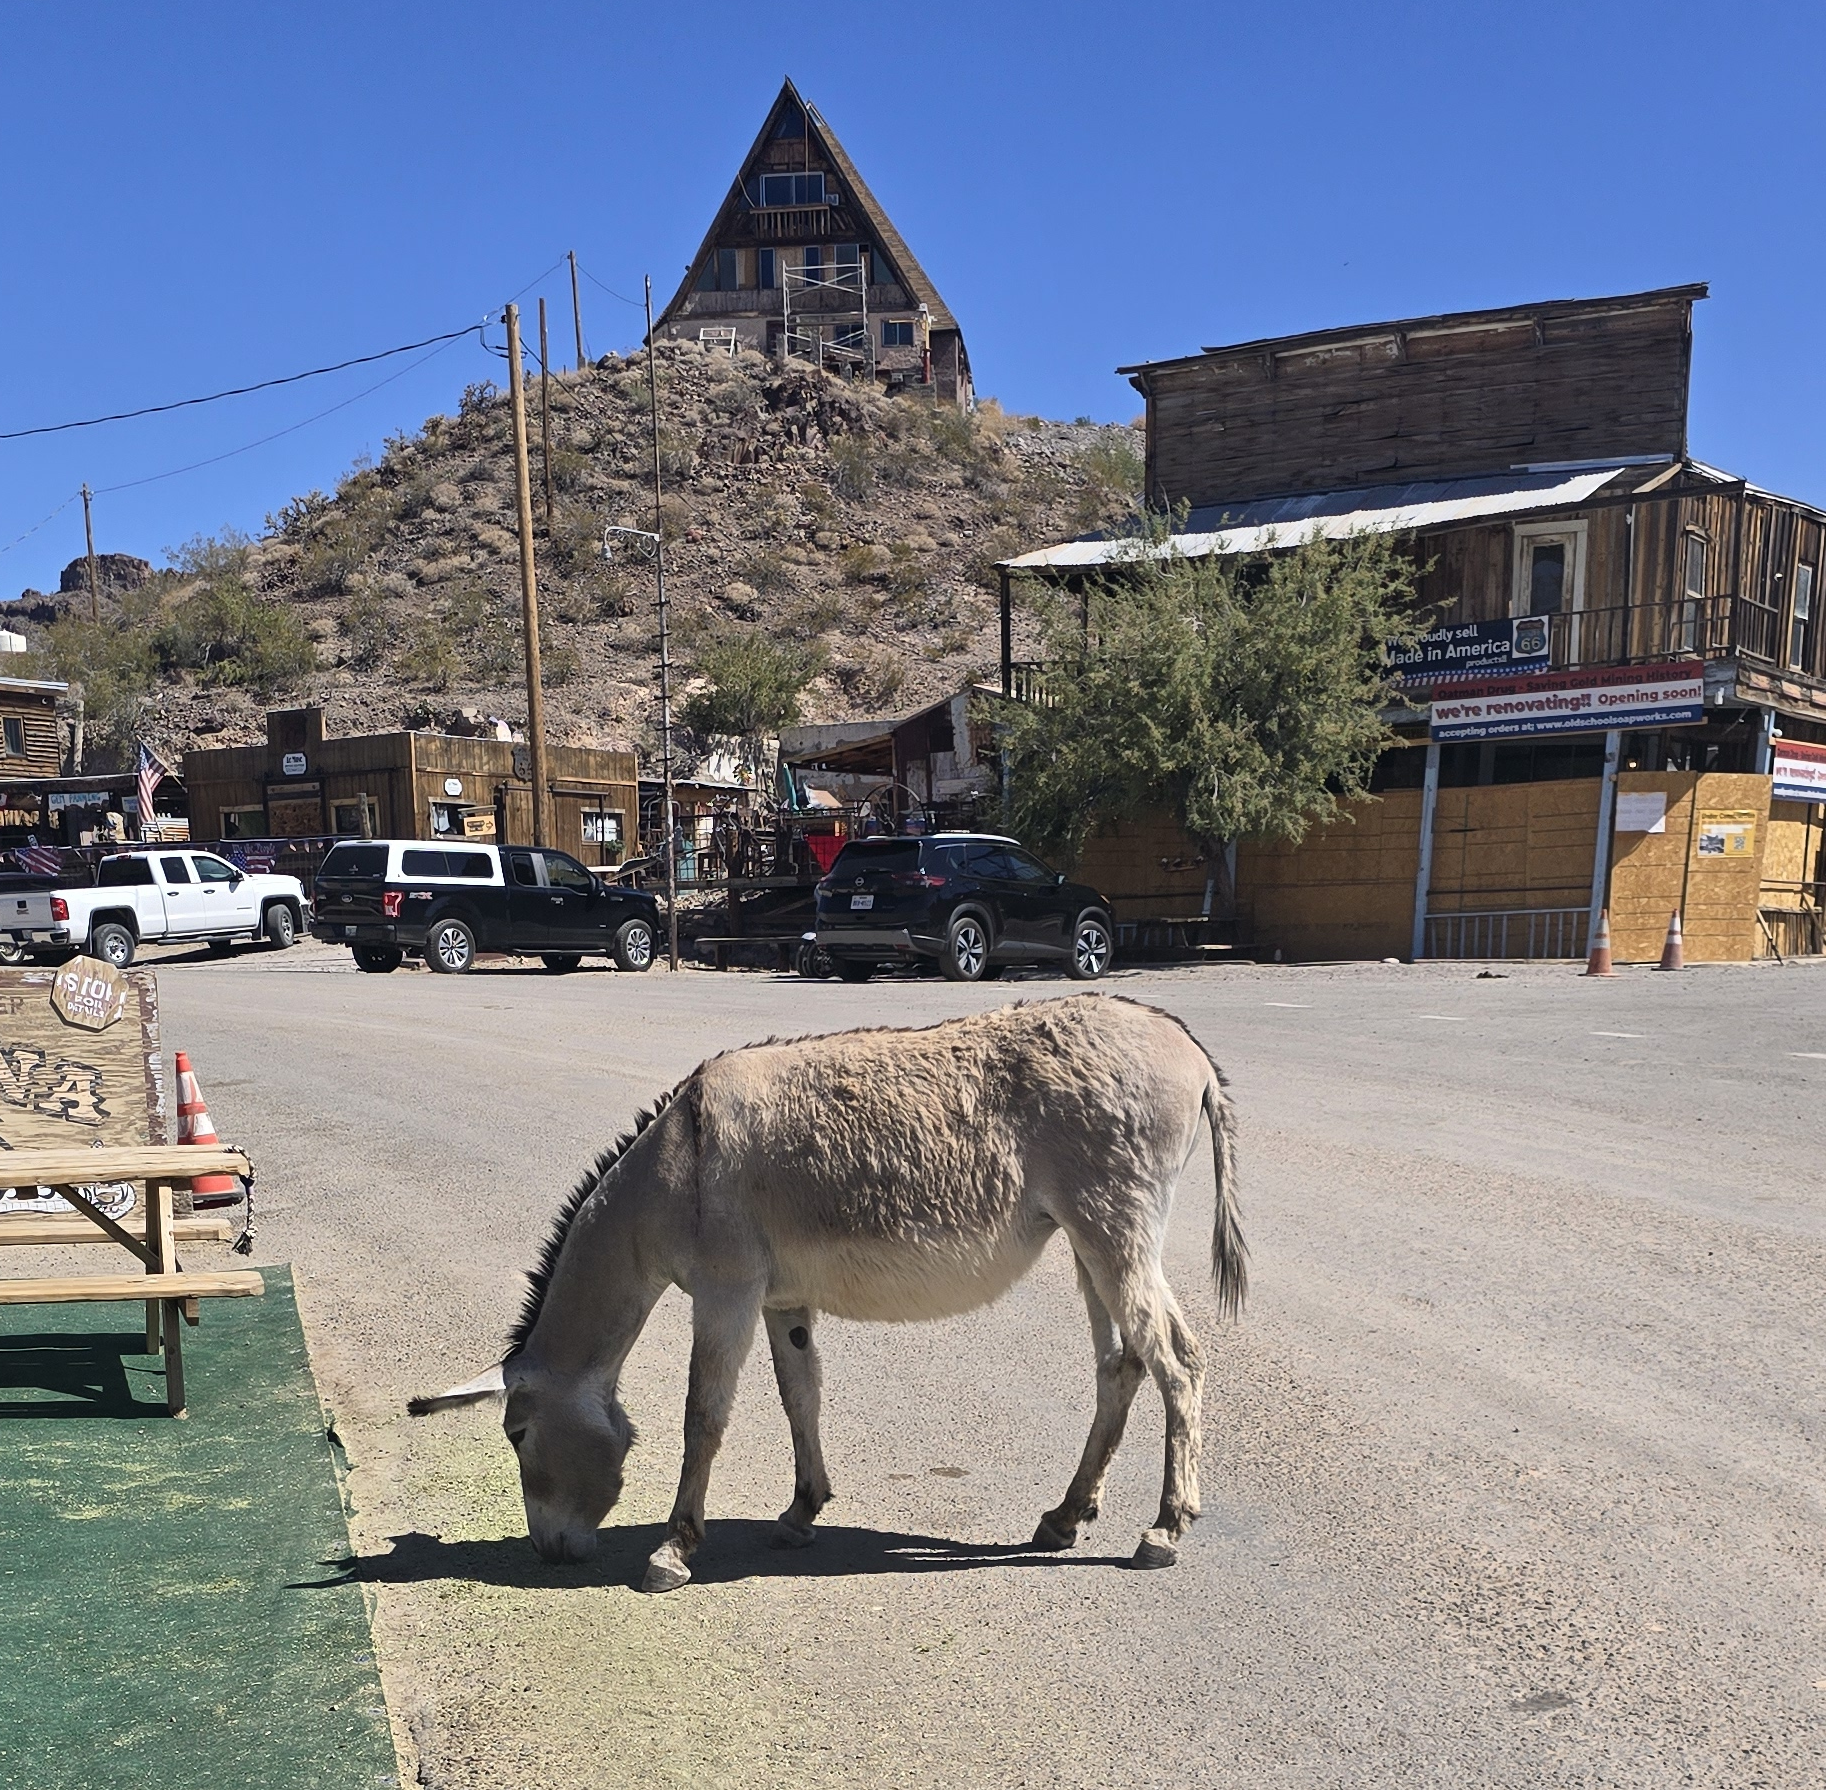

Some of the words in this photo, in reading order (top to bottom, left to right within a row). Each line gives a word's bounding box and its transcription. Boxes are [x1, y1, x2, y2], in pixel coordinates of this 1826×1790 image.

[1455, 624, 1478, 639] sell
[1520, 636, 1541, 651] 66
[1427, 646, 1442, 662] in
[1445, 639, 1510, 660] America
[1438, 688, 1484, 700] Oatman
[1487, 685, 1517, 696] Drug
[1527, 680, 1567, 692] Saving
[1570, 676, 1598, 688] Gold
[1601, 672, 1643, 685] Mining
[1646, 669, 1692, 682] History
[1435, 703, 1482, 719] we're
[1486, 693, 1592, 716] renovating!!
[1598, 689, 1659, 706] Opening
[1662, 686, 1702, 700] soon!
[1438, 726, 1487, 738] accepting
[1488, 723, 1520, 734] orders
[1536, 711, 1692, 729] www.oldschoolsoapworks.com
